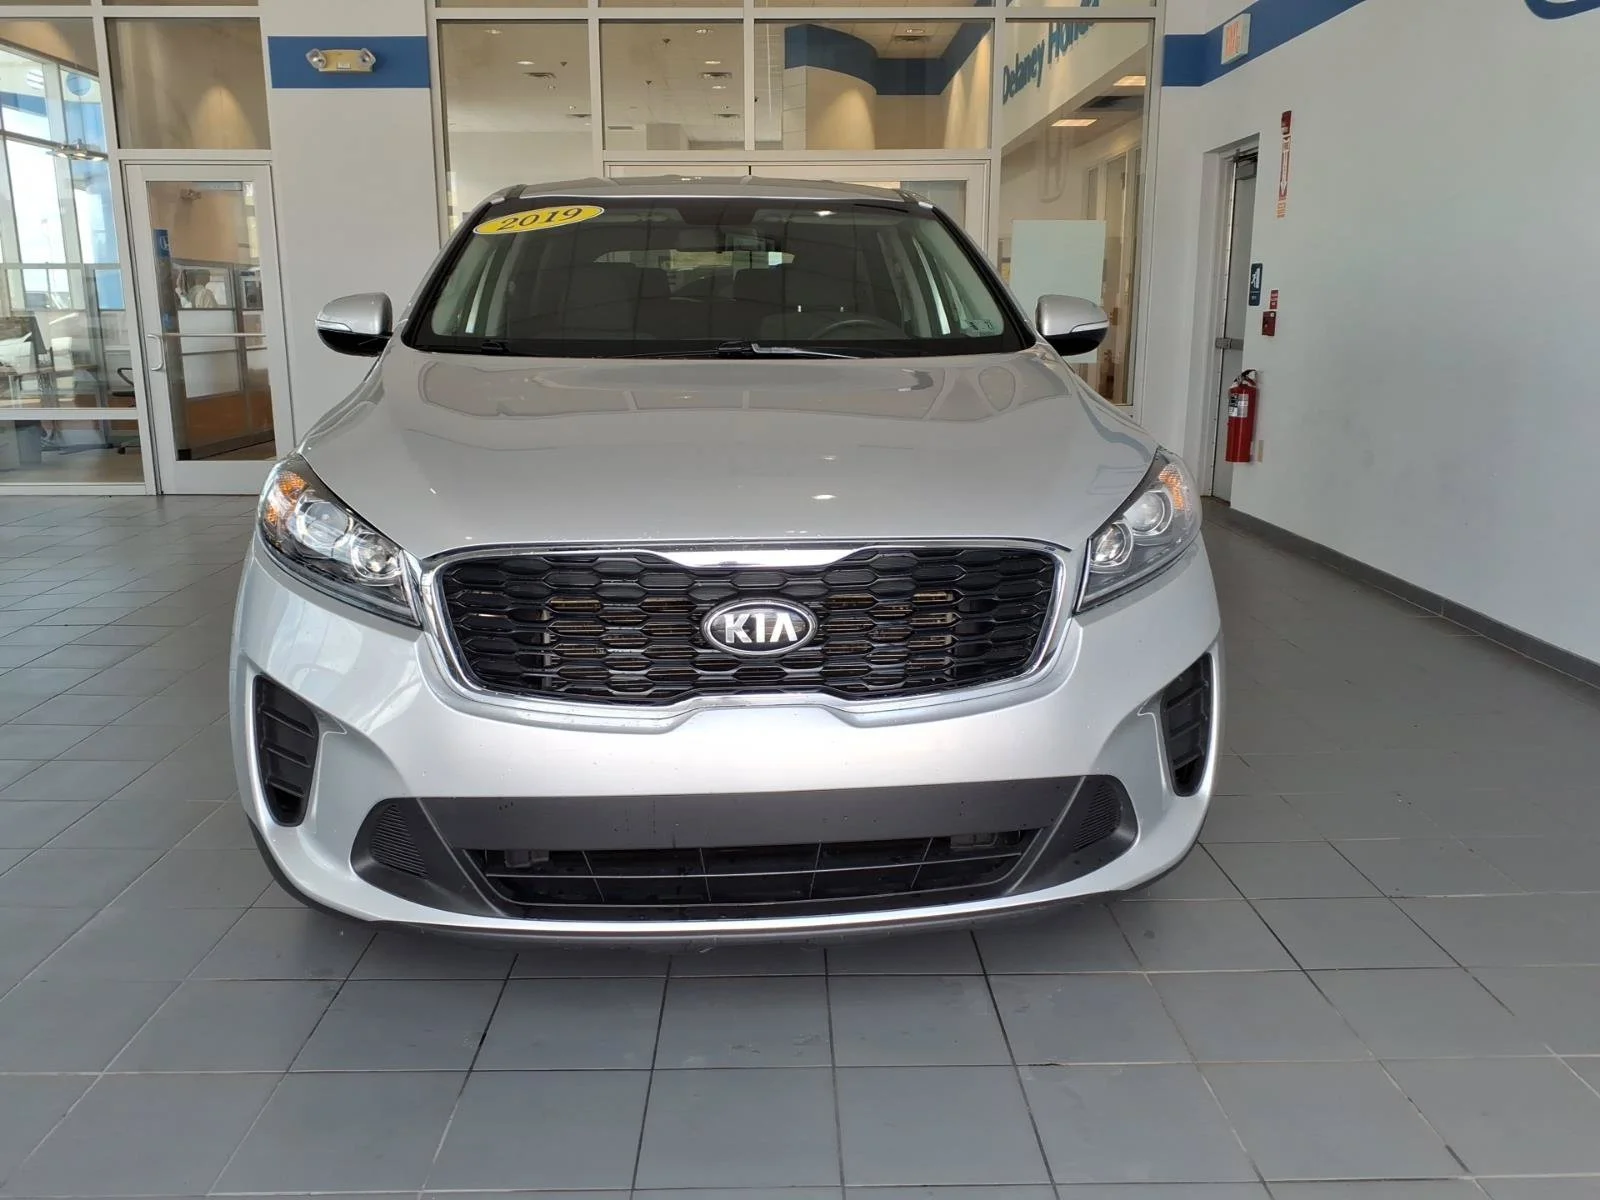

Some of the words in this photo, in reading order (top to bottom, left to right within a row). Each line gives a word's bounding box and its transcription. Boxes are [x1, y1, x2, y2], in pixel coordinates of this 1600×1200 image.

[1003, 40, 1045, 105] Delaney
[1047, 8, 1097, 64] Hon
[496, 207, 583, 231] 2019
[723, 612, 798, 644] KIA
